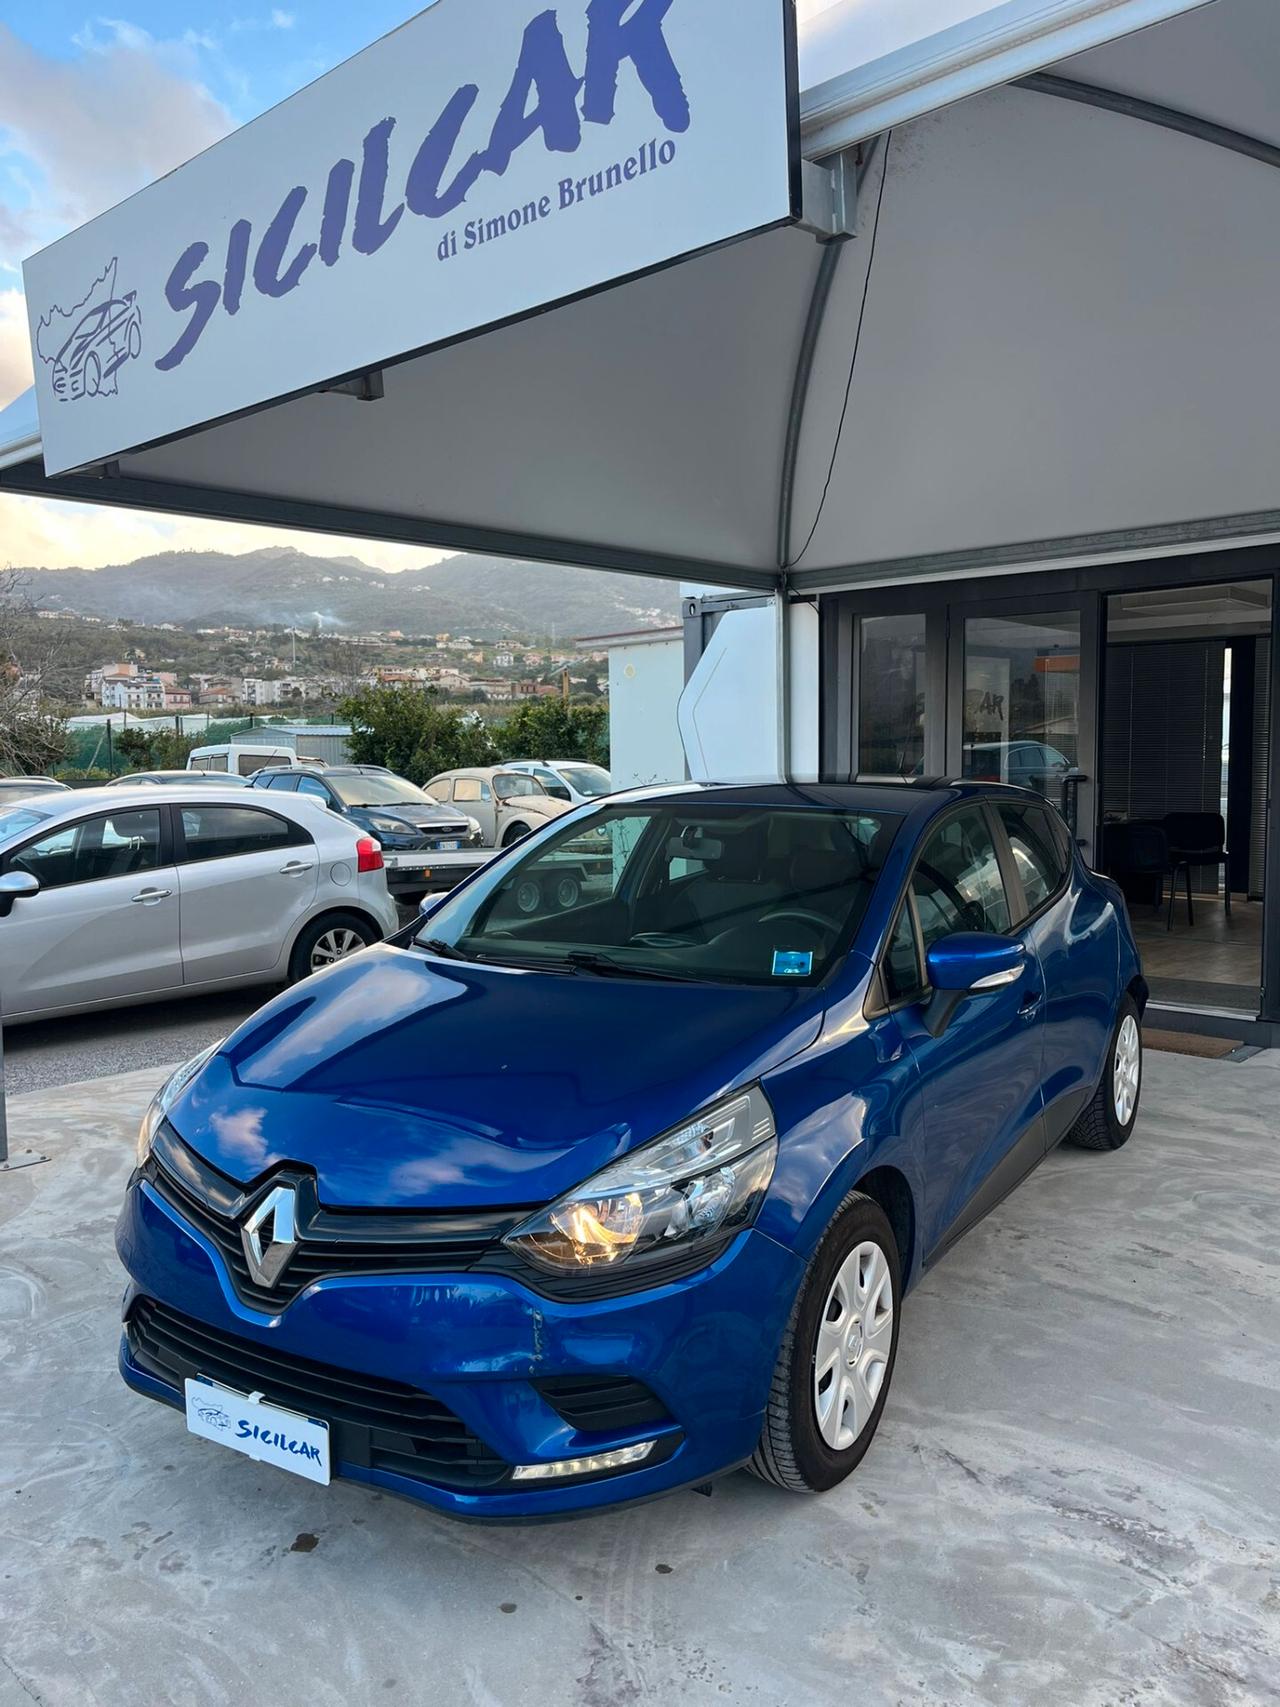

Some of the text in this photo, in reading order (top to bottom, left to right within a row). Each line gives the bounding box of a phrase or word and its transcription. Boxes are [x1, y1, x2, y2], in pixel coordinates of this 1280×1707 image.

[155, 0, 690, 371] SICILCAR
[437, 138, 676, 261] di Simone Brunello
[235, 1420, 322, 1467] SICILCAR
